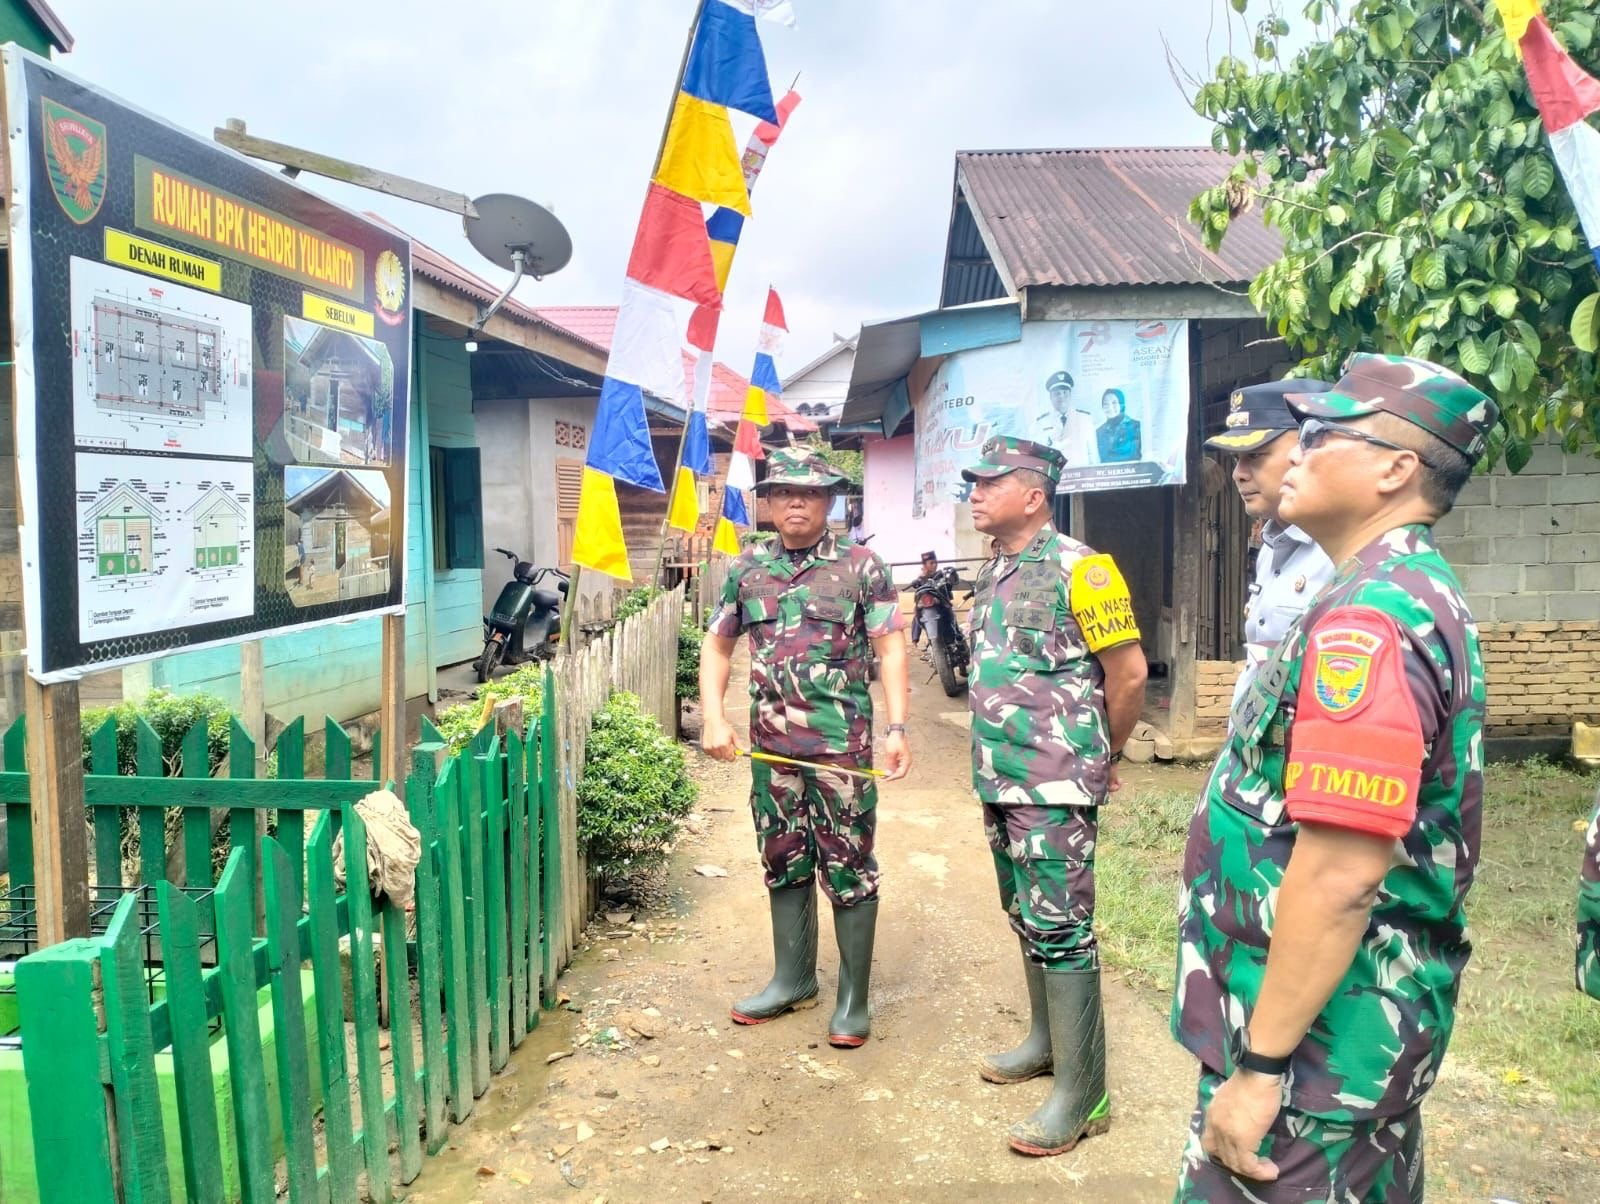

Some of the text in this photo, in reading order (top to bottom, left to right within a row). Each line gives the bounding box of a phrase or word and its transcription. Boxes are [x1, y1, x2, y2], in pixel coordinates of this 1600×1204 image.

[153, 171, 355, 291] RUMAH BPK HENDRI YULIANTO
[128, 243, 205, 280] DENAH RUMAH
[324, 305, 356, 325] SEBELUM
[1133, 345, 1172, 356] ASEAN
[944, 396, 975, 409] TEBO
[1076, 605, 1098, 627] TIM
[1310, 761, 1409, 808] TMMD
